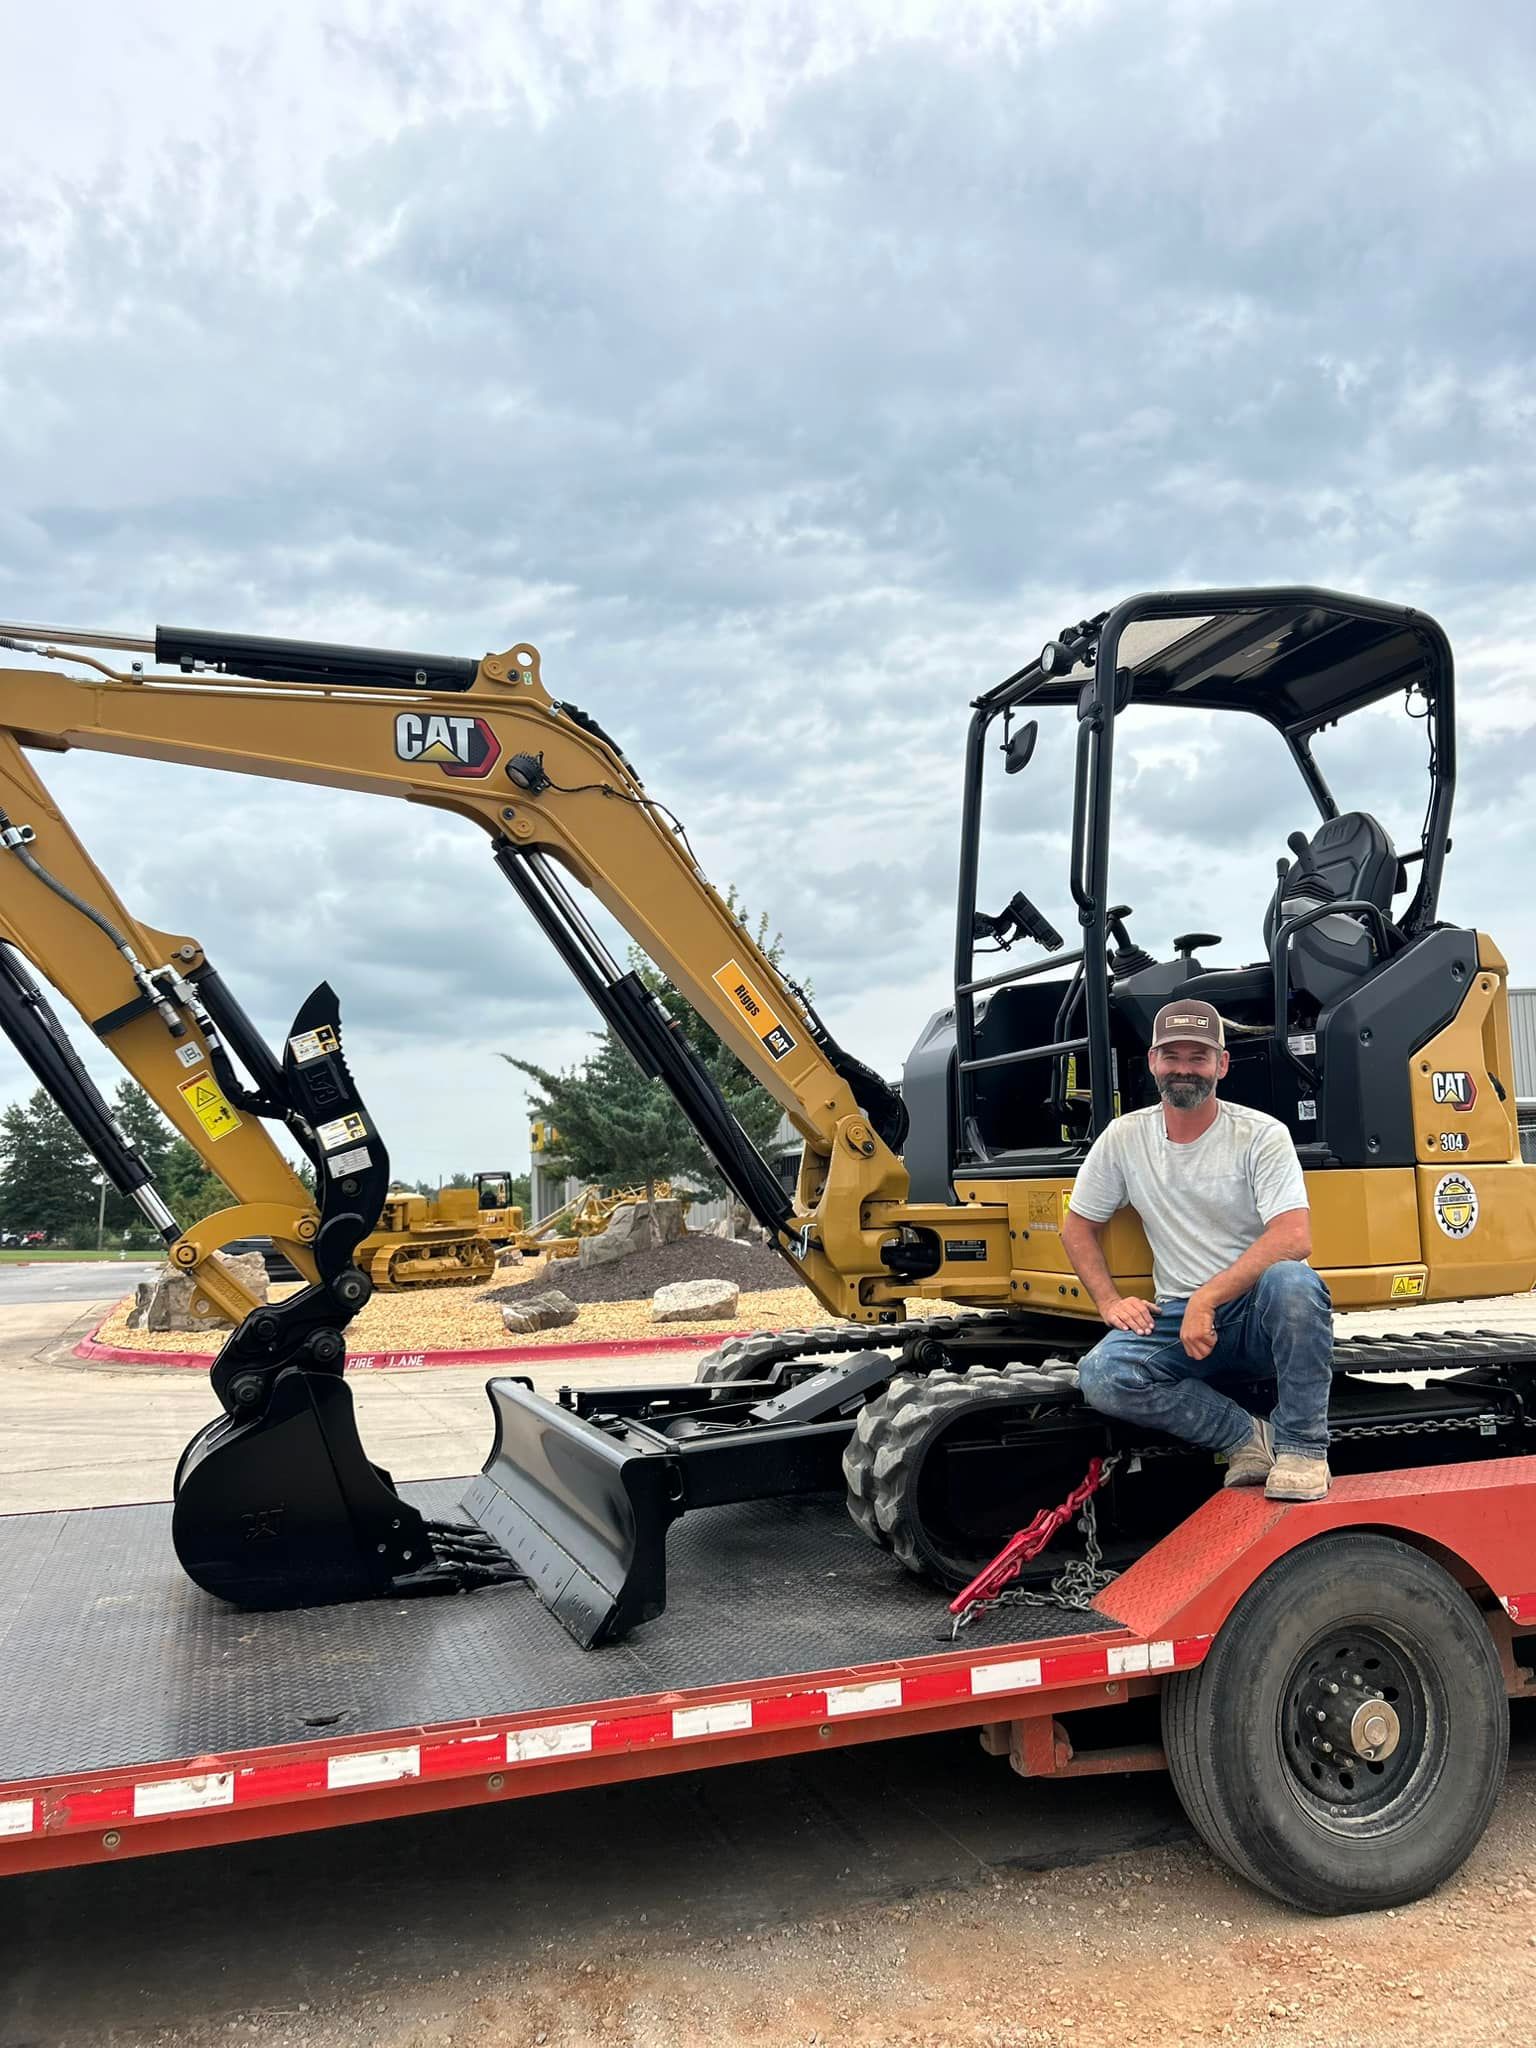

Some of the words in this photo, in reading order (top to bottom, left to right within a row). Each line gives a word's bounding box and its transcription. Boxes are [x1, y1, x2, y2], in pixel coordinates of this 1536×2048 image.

[396, 713, 475, 763] CAT
[733, 983, 760, 1017] Riggs
[768, 1030, 790, 1053] CAT
[1432, 1072, 1466, 1103] CAT
[1440, 1133, 1463, 1151] 304
[347, 1356, 375, 1369] FIRE
[389, 1354, 425, 1367] LANE
